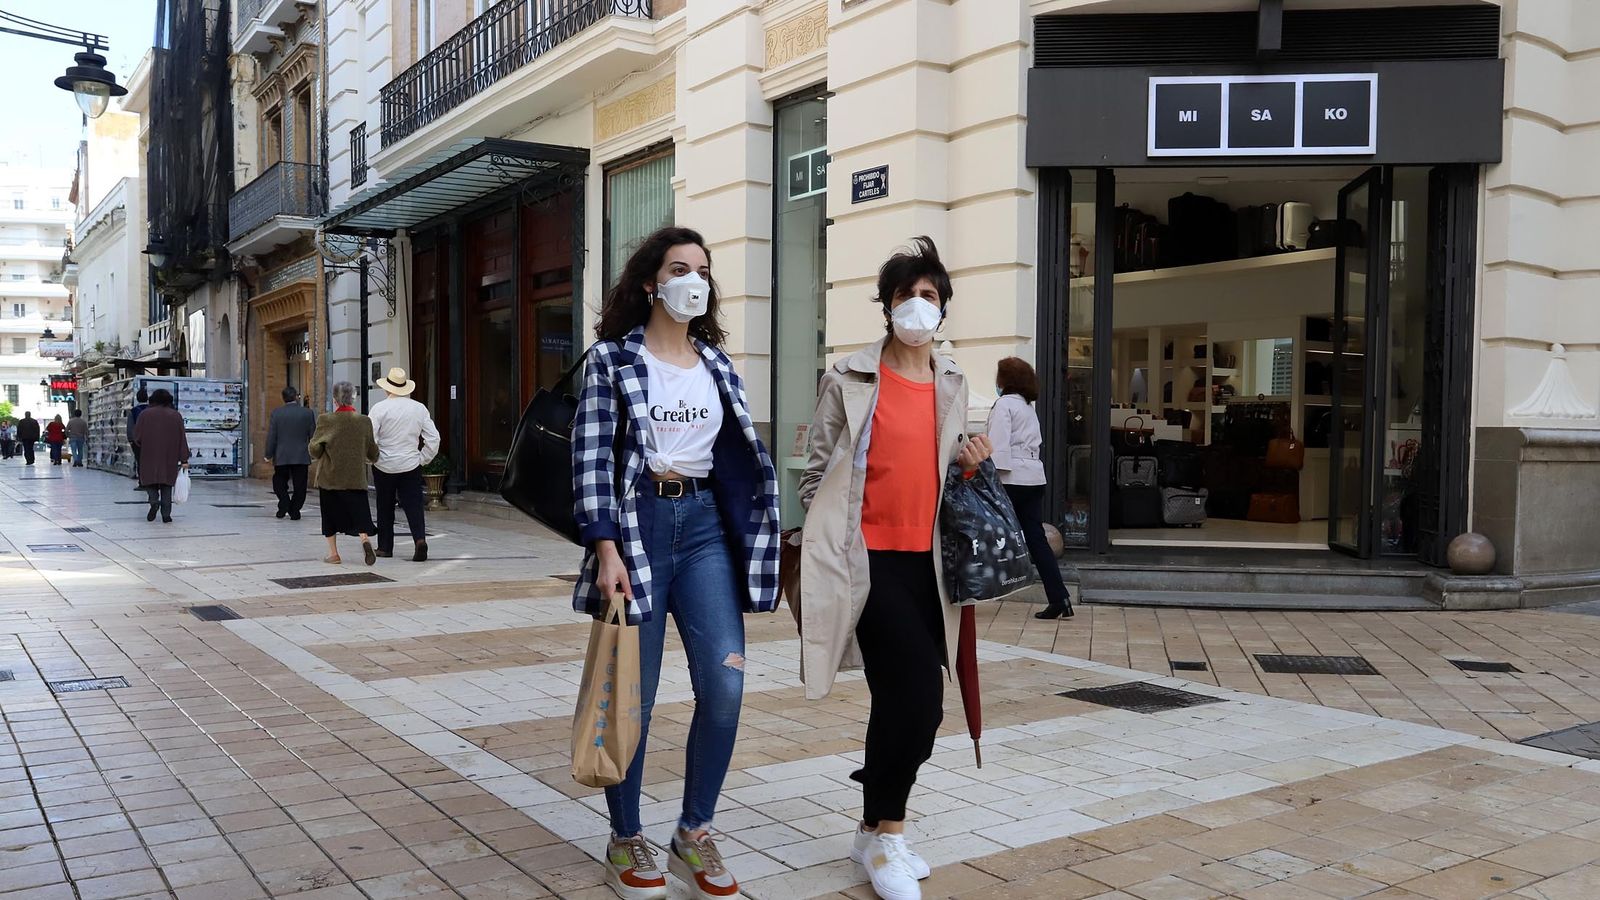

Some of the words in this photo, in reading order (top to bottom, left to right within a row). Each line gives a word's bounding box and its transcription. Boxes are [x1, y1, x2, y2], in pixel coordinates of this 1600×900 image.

[1178, 110, 1198, 122] MI
[1250, 108, 1273, 121] SA
[1324, 107, 1348, 120] KO
[796, 171, 804, 181] MI
[816, 166, 825, 176] SA
[859, 171, 880, 182] PROHIBIDO
[863, 181, 874, 189] FIJAR
[859, 188, 880, 198] CARTELES
[678, 399, 687, 409] Be
